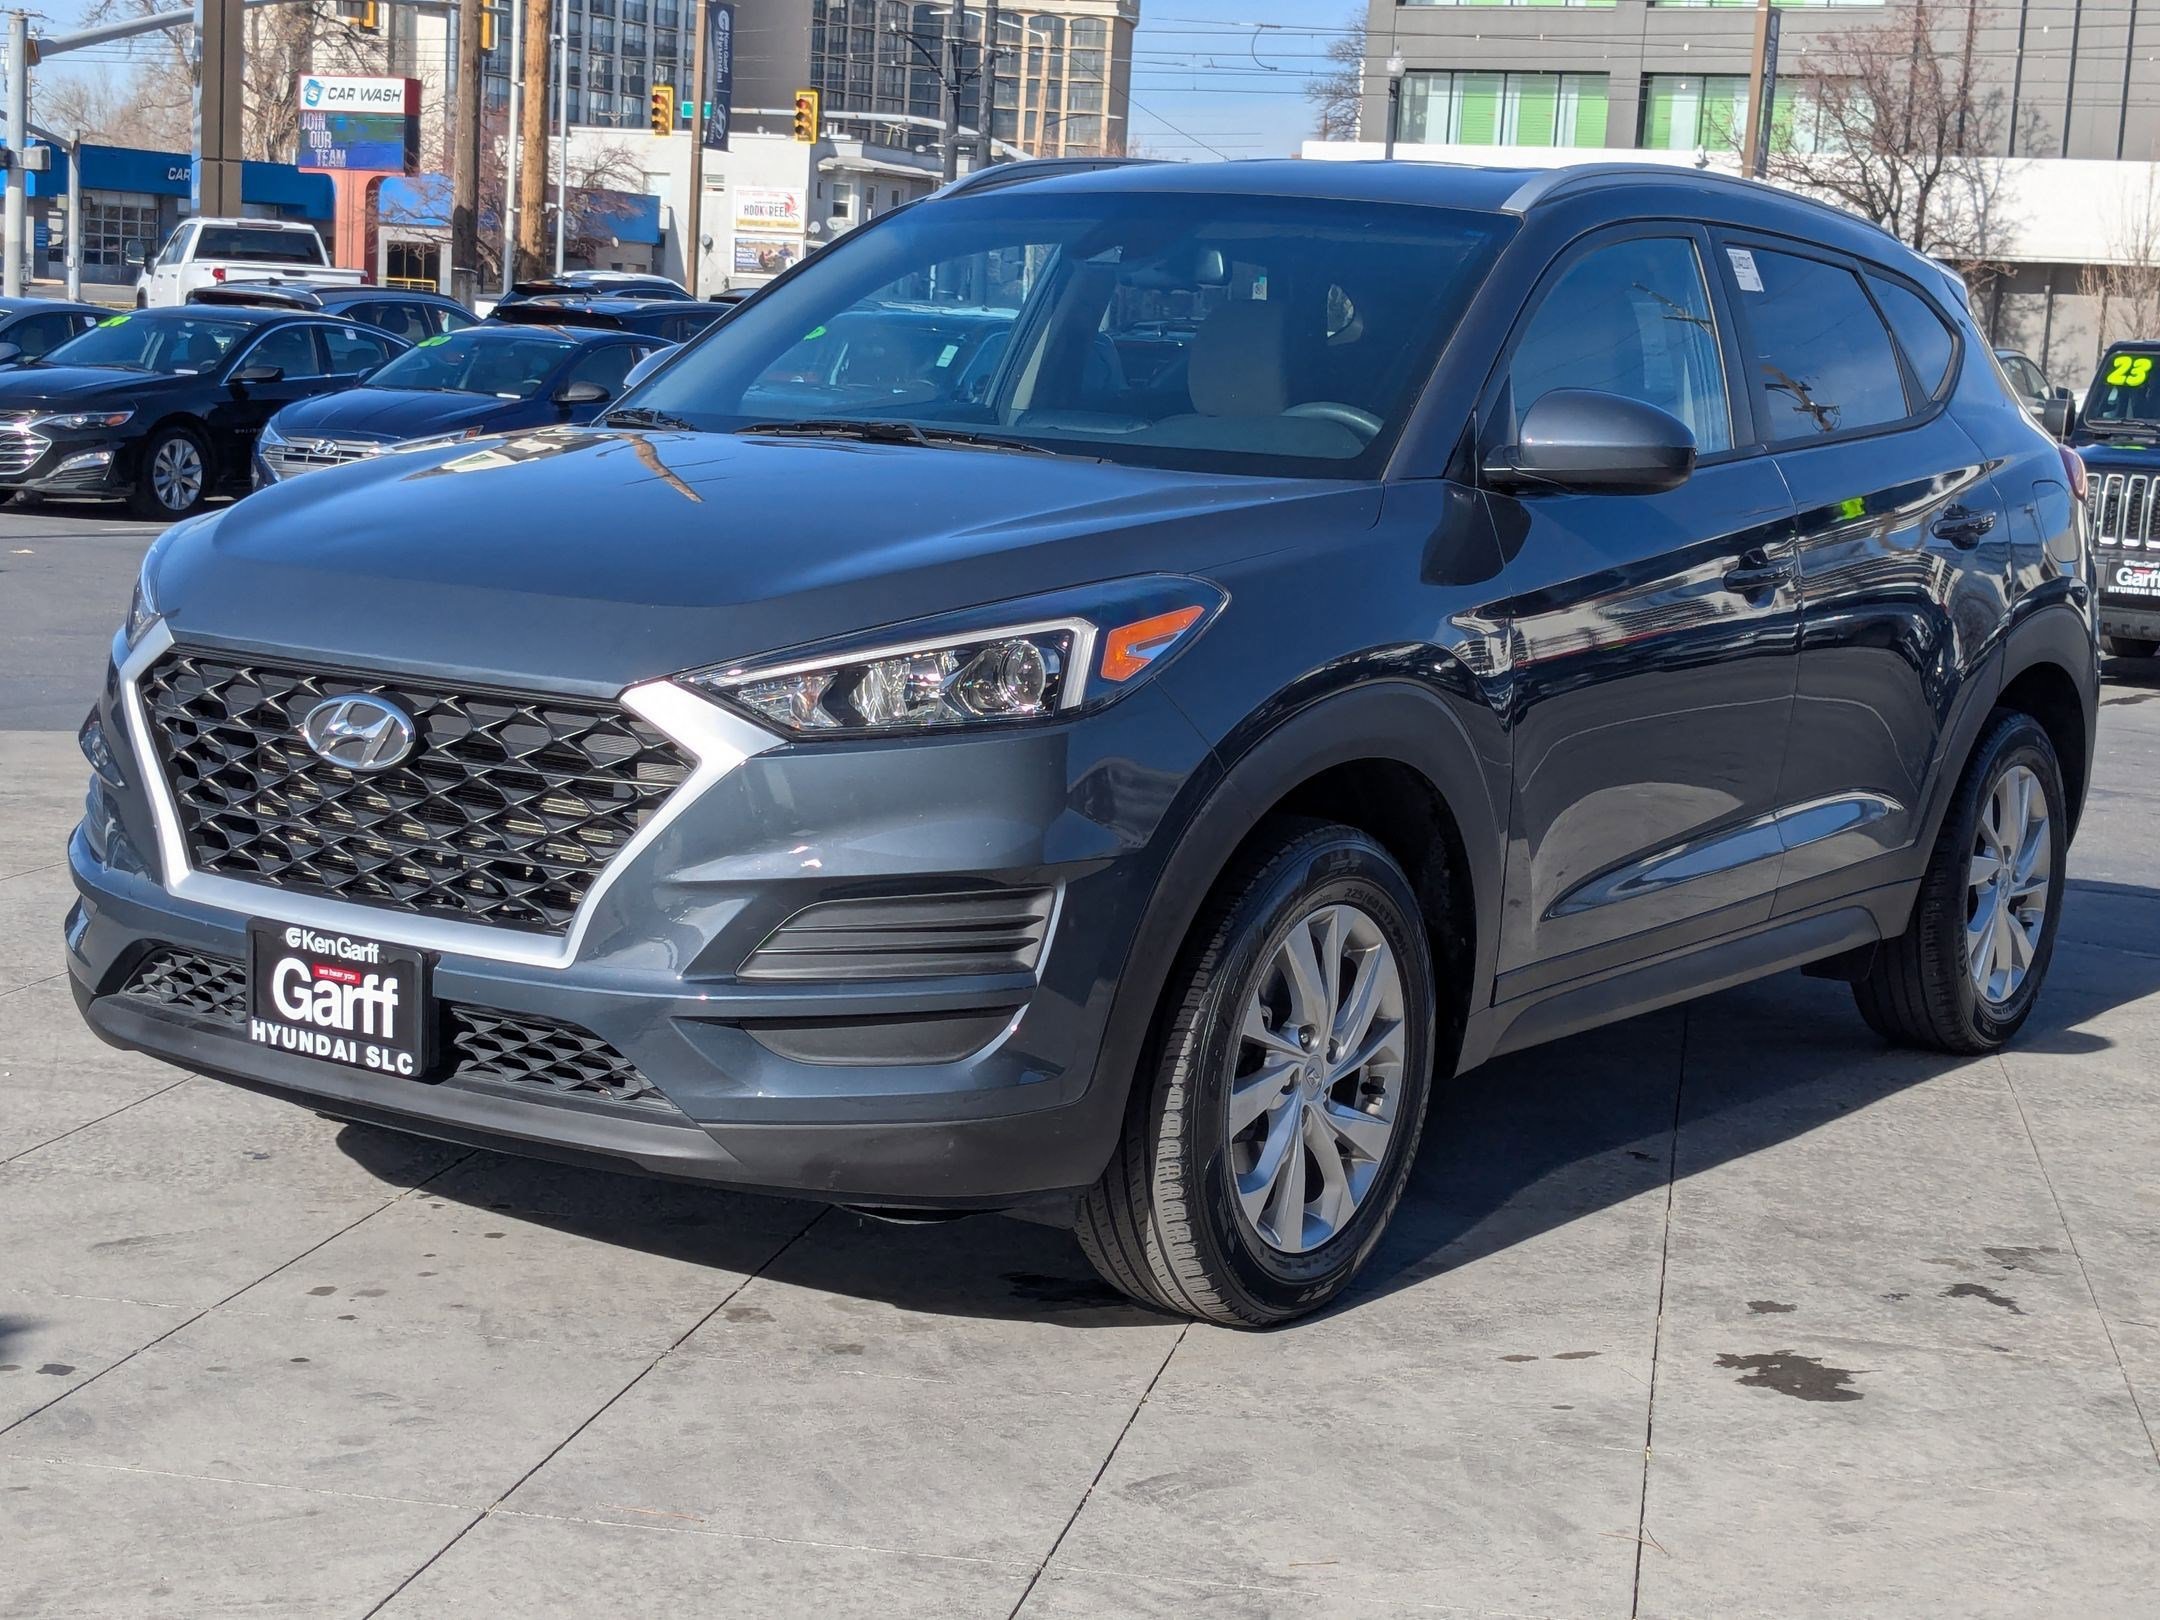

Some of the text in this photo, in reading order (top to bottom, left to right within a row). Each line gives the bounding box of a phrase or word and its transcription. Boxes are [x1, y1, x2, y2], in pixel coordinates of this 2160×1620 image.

[328, 87, 356, 101] CAR
[360, 88, 402, 102] WASH
[302, 112, 327, 130] JOIN
[310, 130, 332, 148] OUR
[315, 149, 347, 167] TEAM
[168, 167, 192, 181] CAR
[743, 204, 764, 216] HOOK
[2106, 355, 2152, 387] 23
[2108, 586, 2149, 596] HYUNDAI
[272, 957, 399, 1039] Garff
[251, 1019, 414, 1075] HYUNDAI SLC
